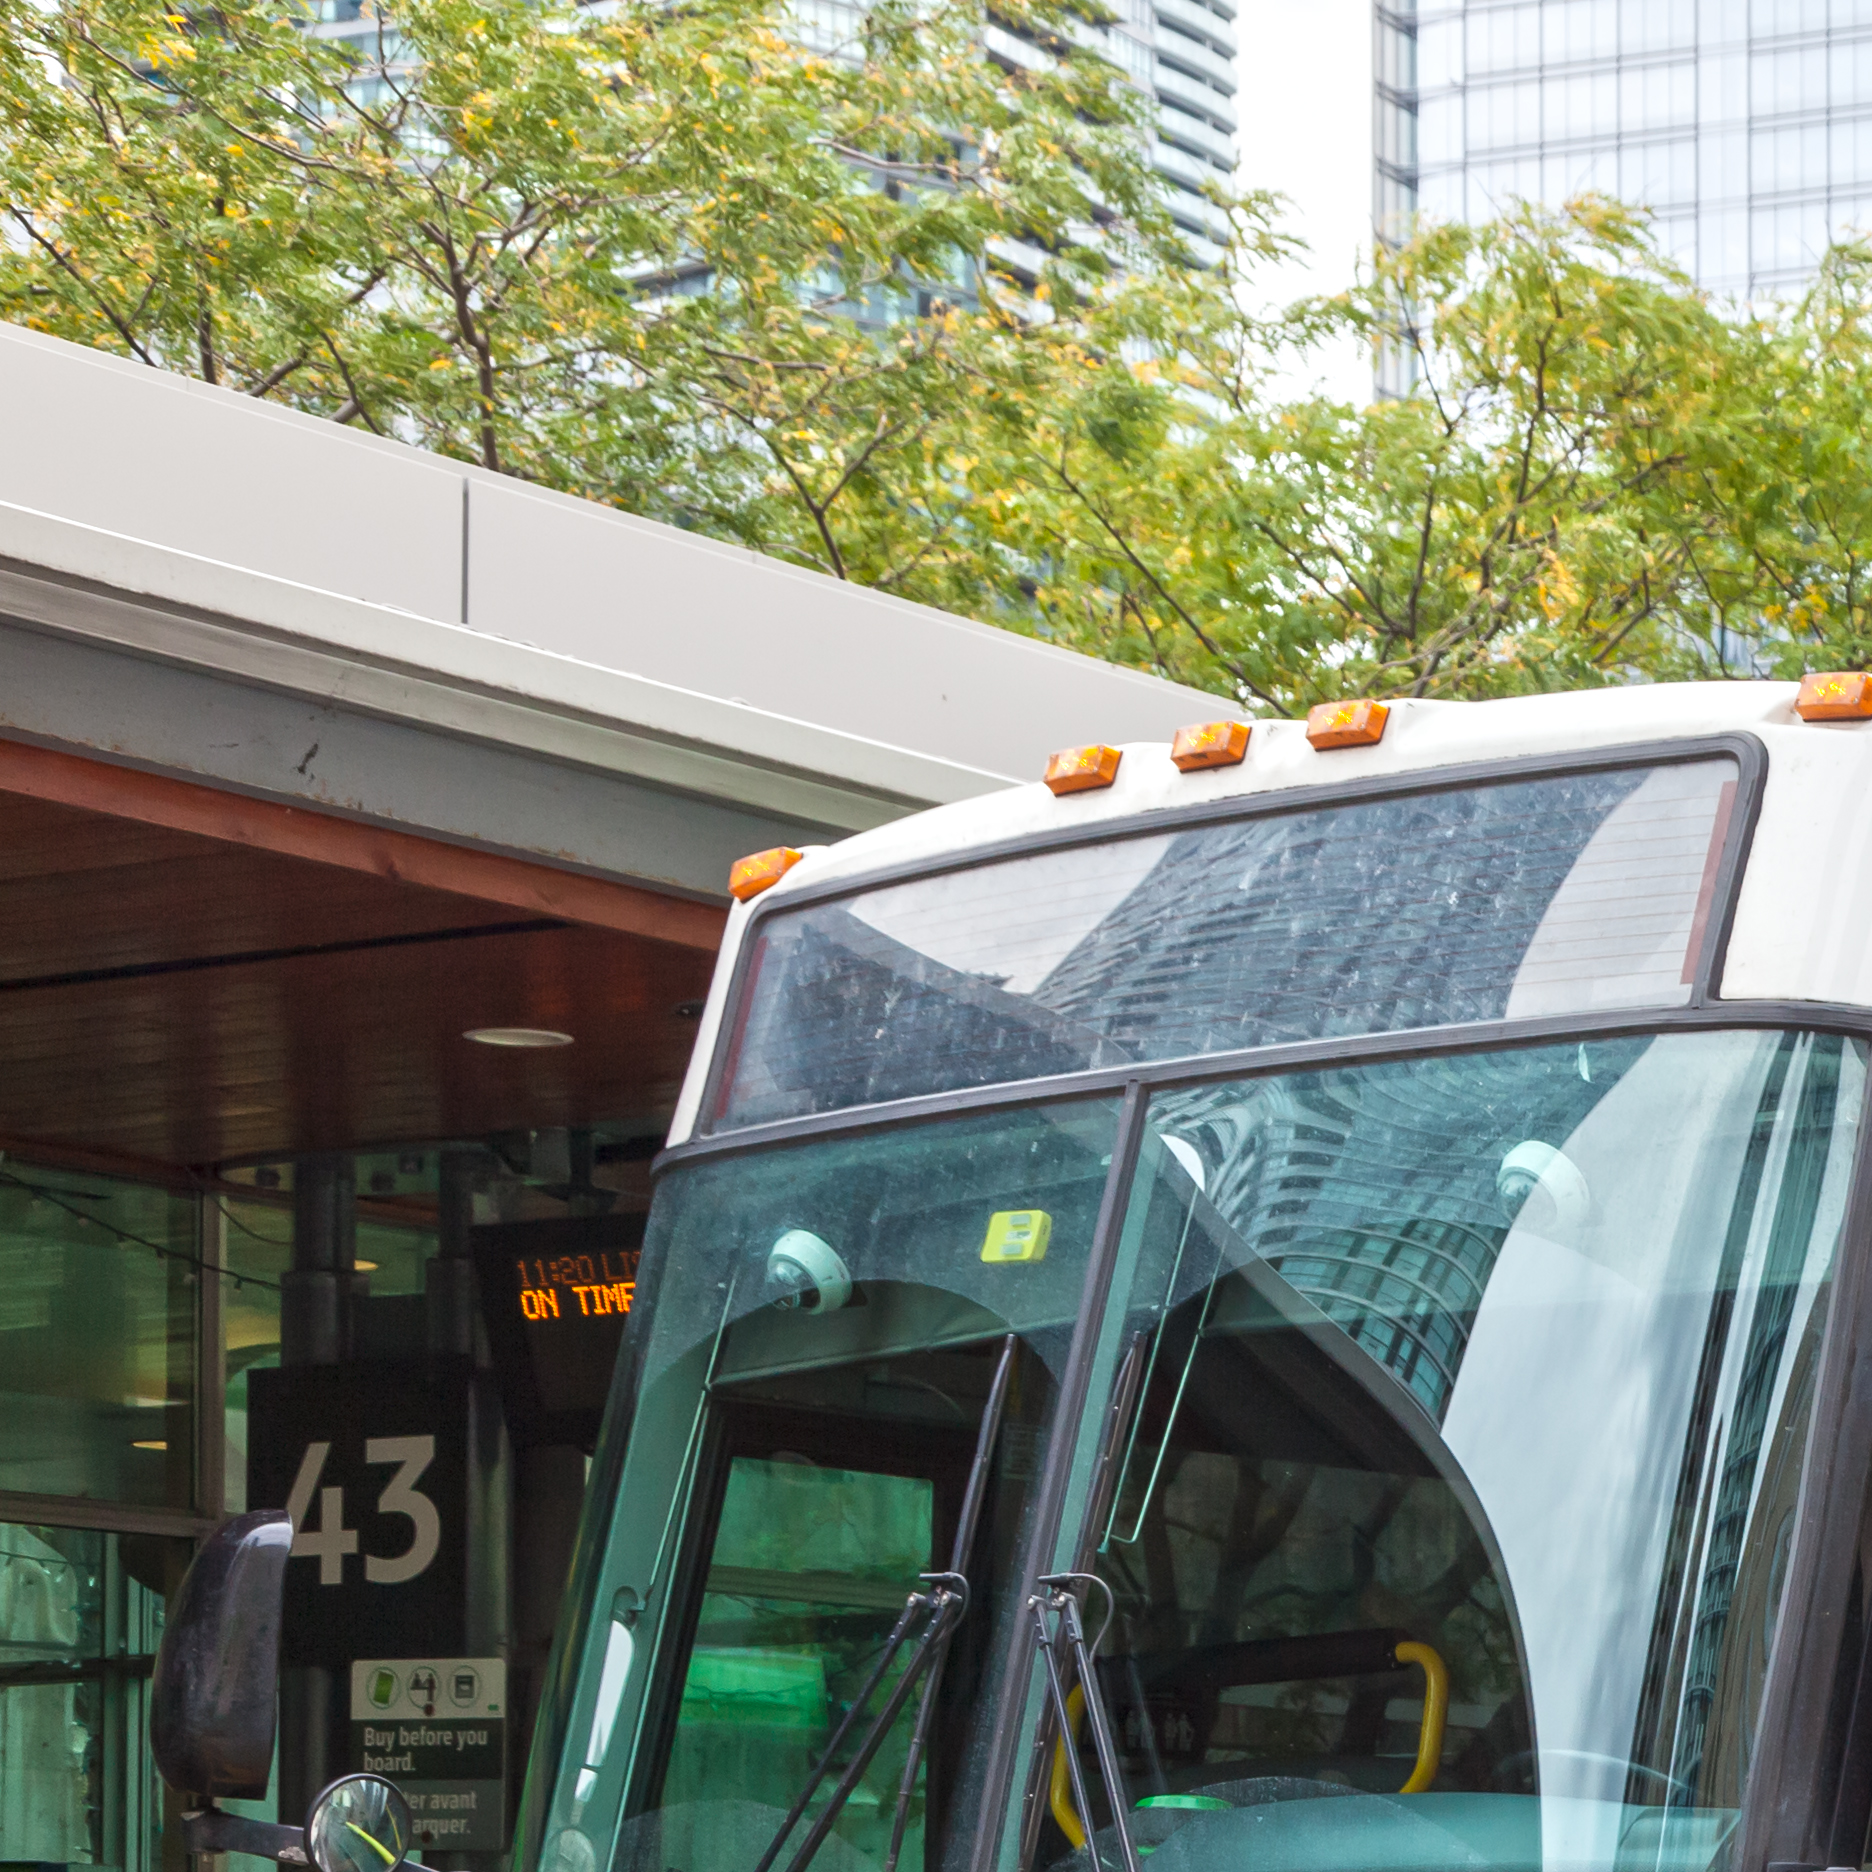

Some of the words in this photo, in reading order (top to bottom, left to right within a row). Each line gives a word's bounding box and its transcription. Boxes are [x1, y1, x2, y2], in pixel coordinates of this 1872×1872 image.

[517, 1255, 595, 1287] 11:20
[520, 1288, 560, 1320] ON
[286, 1434, 440, 1585] 43
[363, 1727, 395, 1752] Buy
[399, 1725, 453, 1746] before
[456, 1730, 488, 1751] you
[363, 1752, 417, 1772] board.
[430, 1791, 477, 1809] avant
